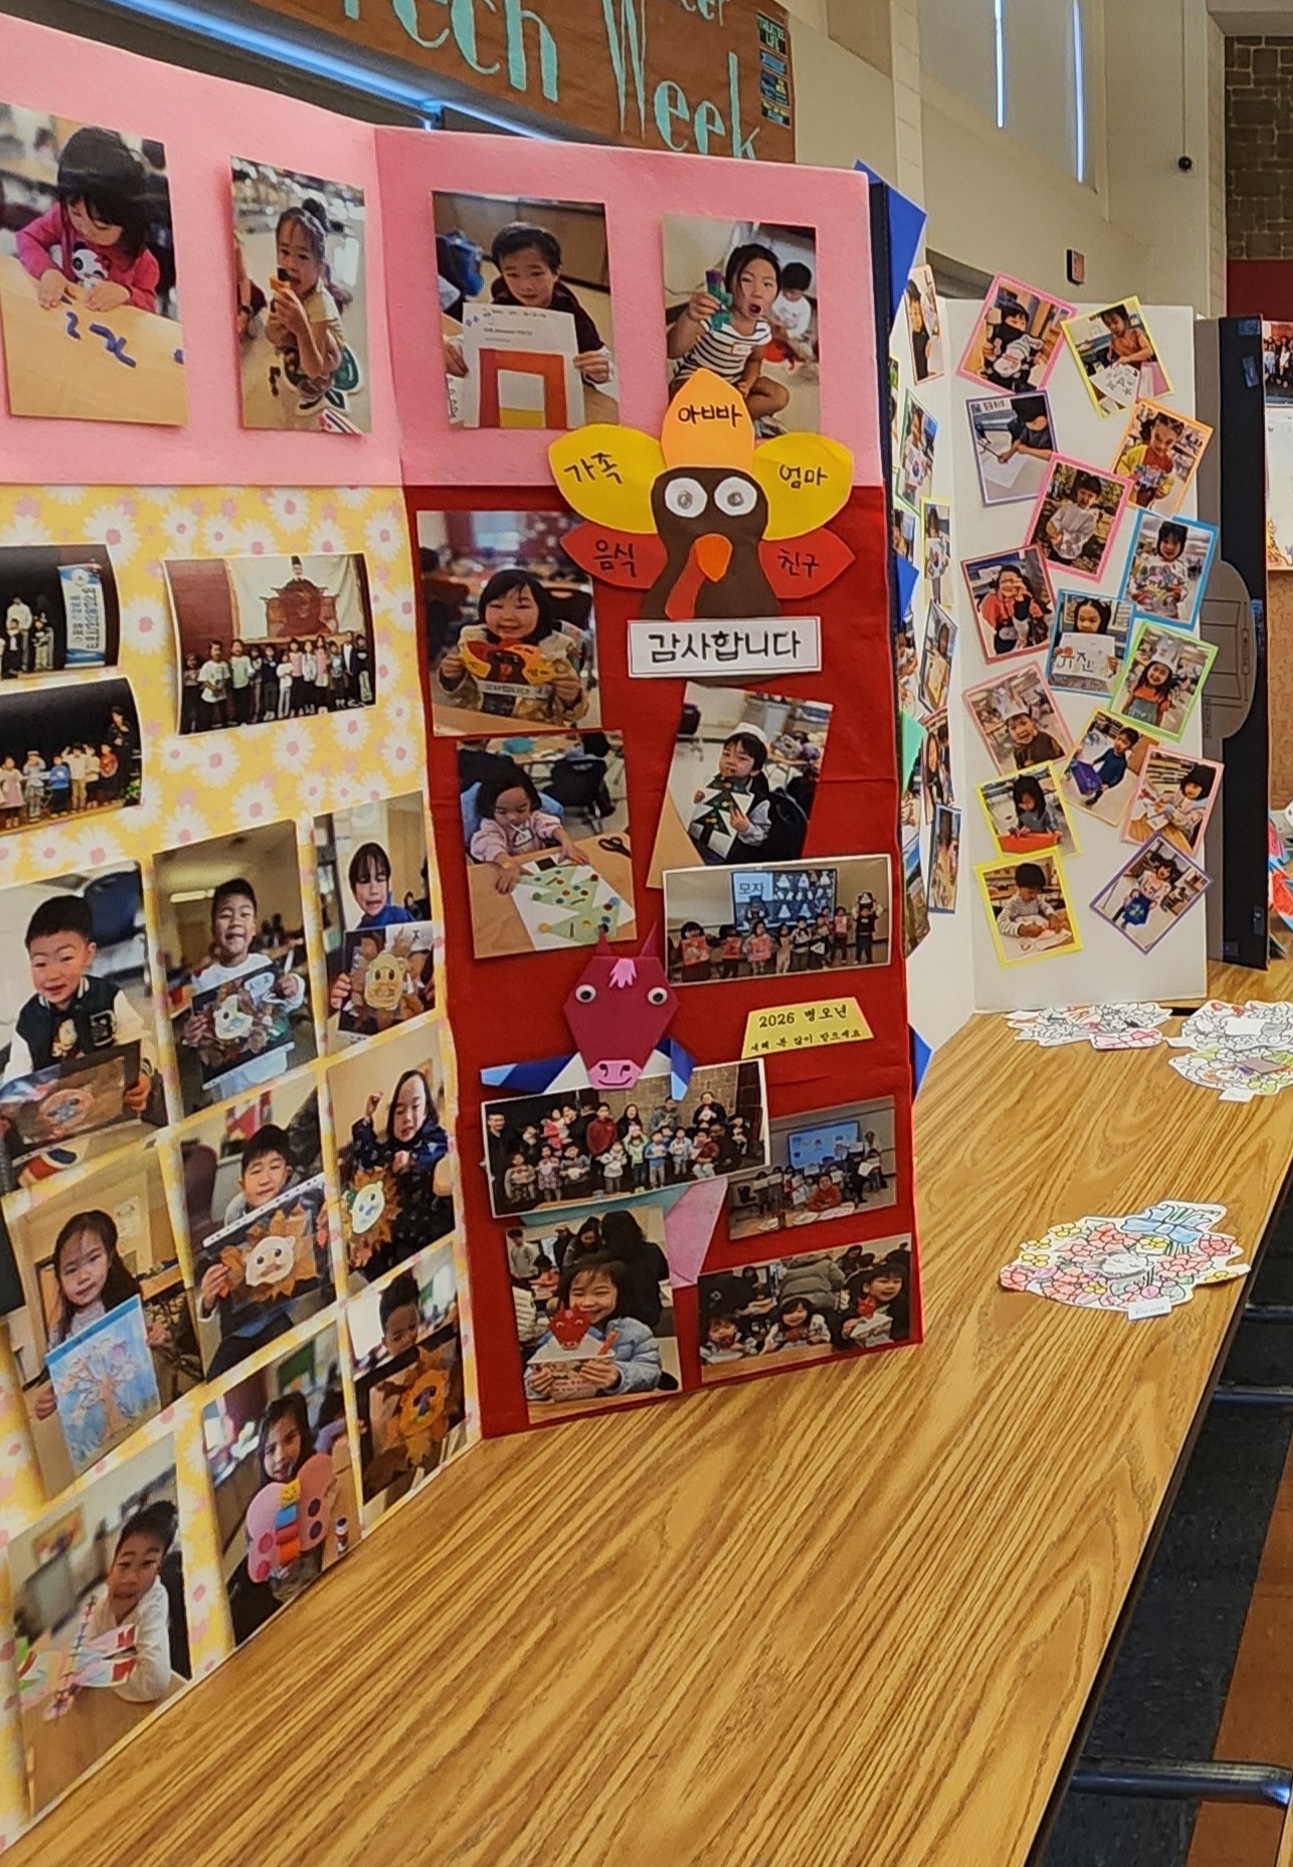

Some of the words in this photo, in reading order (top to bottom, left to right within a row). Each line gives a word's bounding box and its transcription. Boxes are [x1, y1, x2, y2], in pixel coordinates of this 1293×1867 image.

[344, 0, 559, 102] ech
[602, 0, 760, 159] Week
[677, 404, 743, 427] 아빠
[563, 452, 623, 485] 가족
[779, 463, 828, 488] 엄마
[593, 539, 636, 578] 음식
[778, 548, 820, 578] 친구
[648, 630, 802, 663] 감사합니다
[739, 882, 765, 896] 모자
[759, 1011, 795, 1028] 2026
[804, 1004, 847, 1022] 병오년
[793, 1033, 813, 1046] 많이
[820, 1029, 862, 1042] 받으세요
